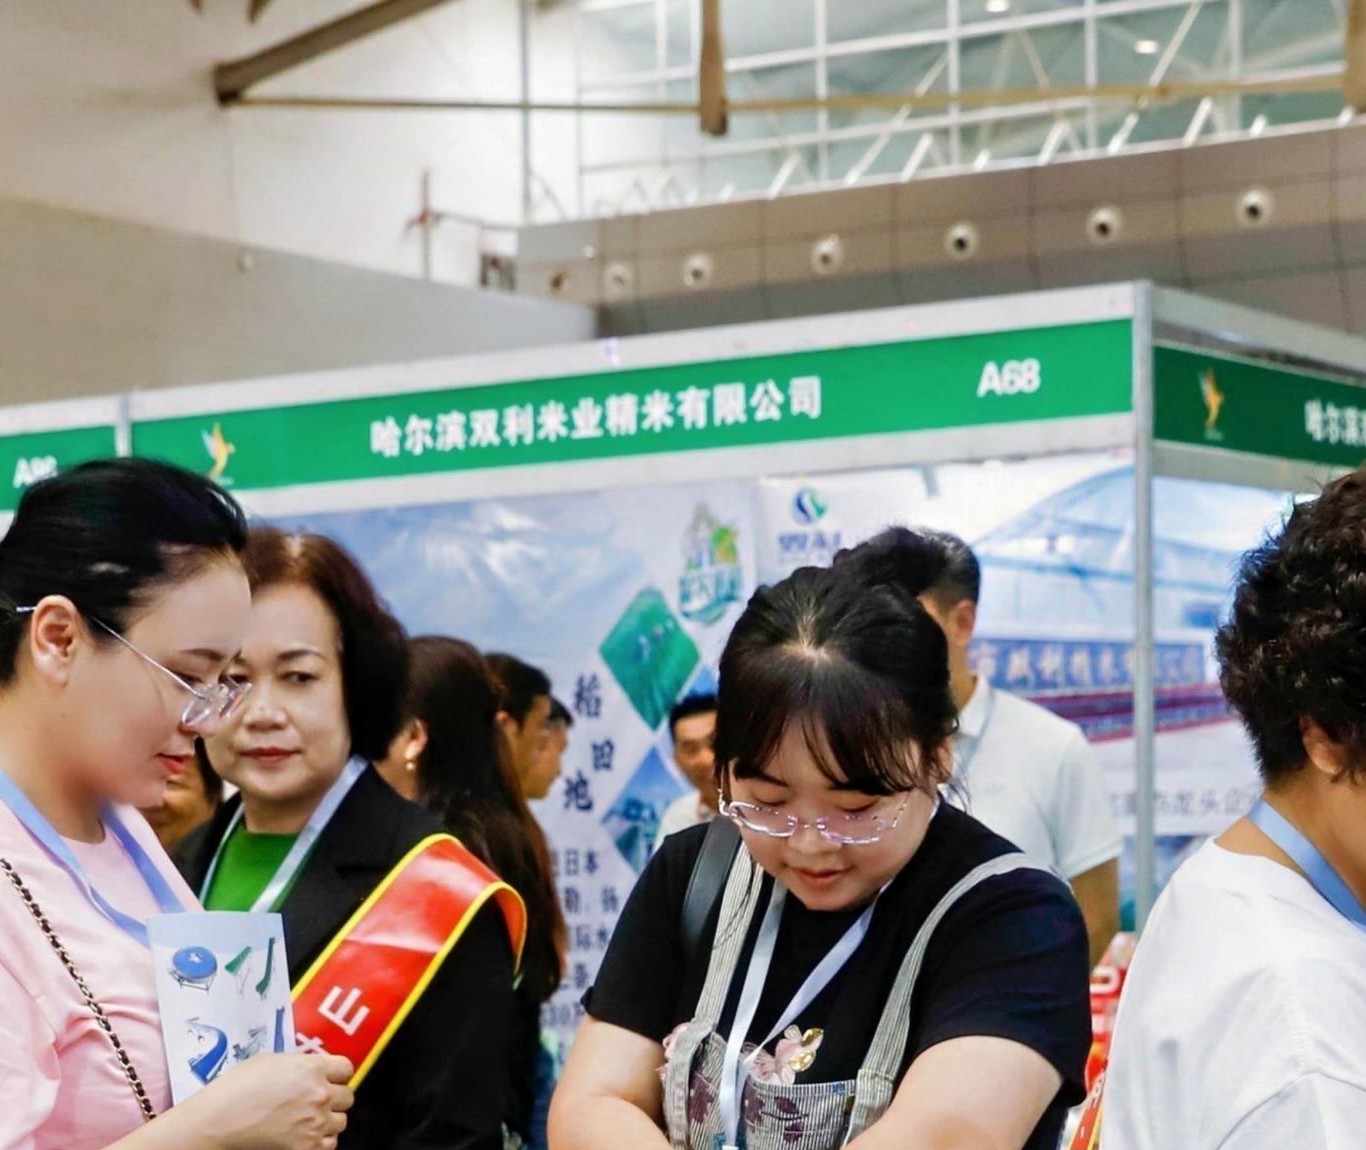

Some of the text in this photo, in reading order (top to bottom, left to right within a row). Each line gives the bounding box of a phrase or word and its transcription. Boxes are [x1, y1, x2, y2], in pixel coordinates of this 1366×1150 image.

[977, 359, 1040, 398] A68
[370, 376, 822, 459] 哈尔滨双利米业精米有限公司
